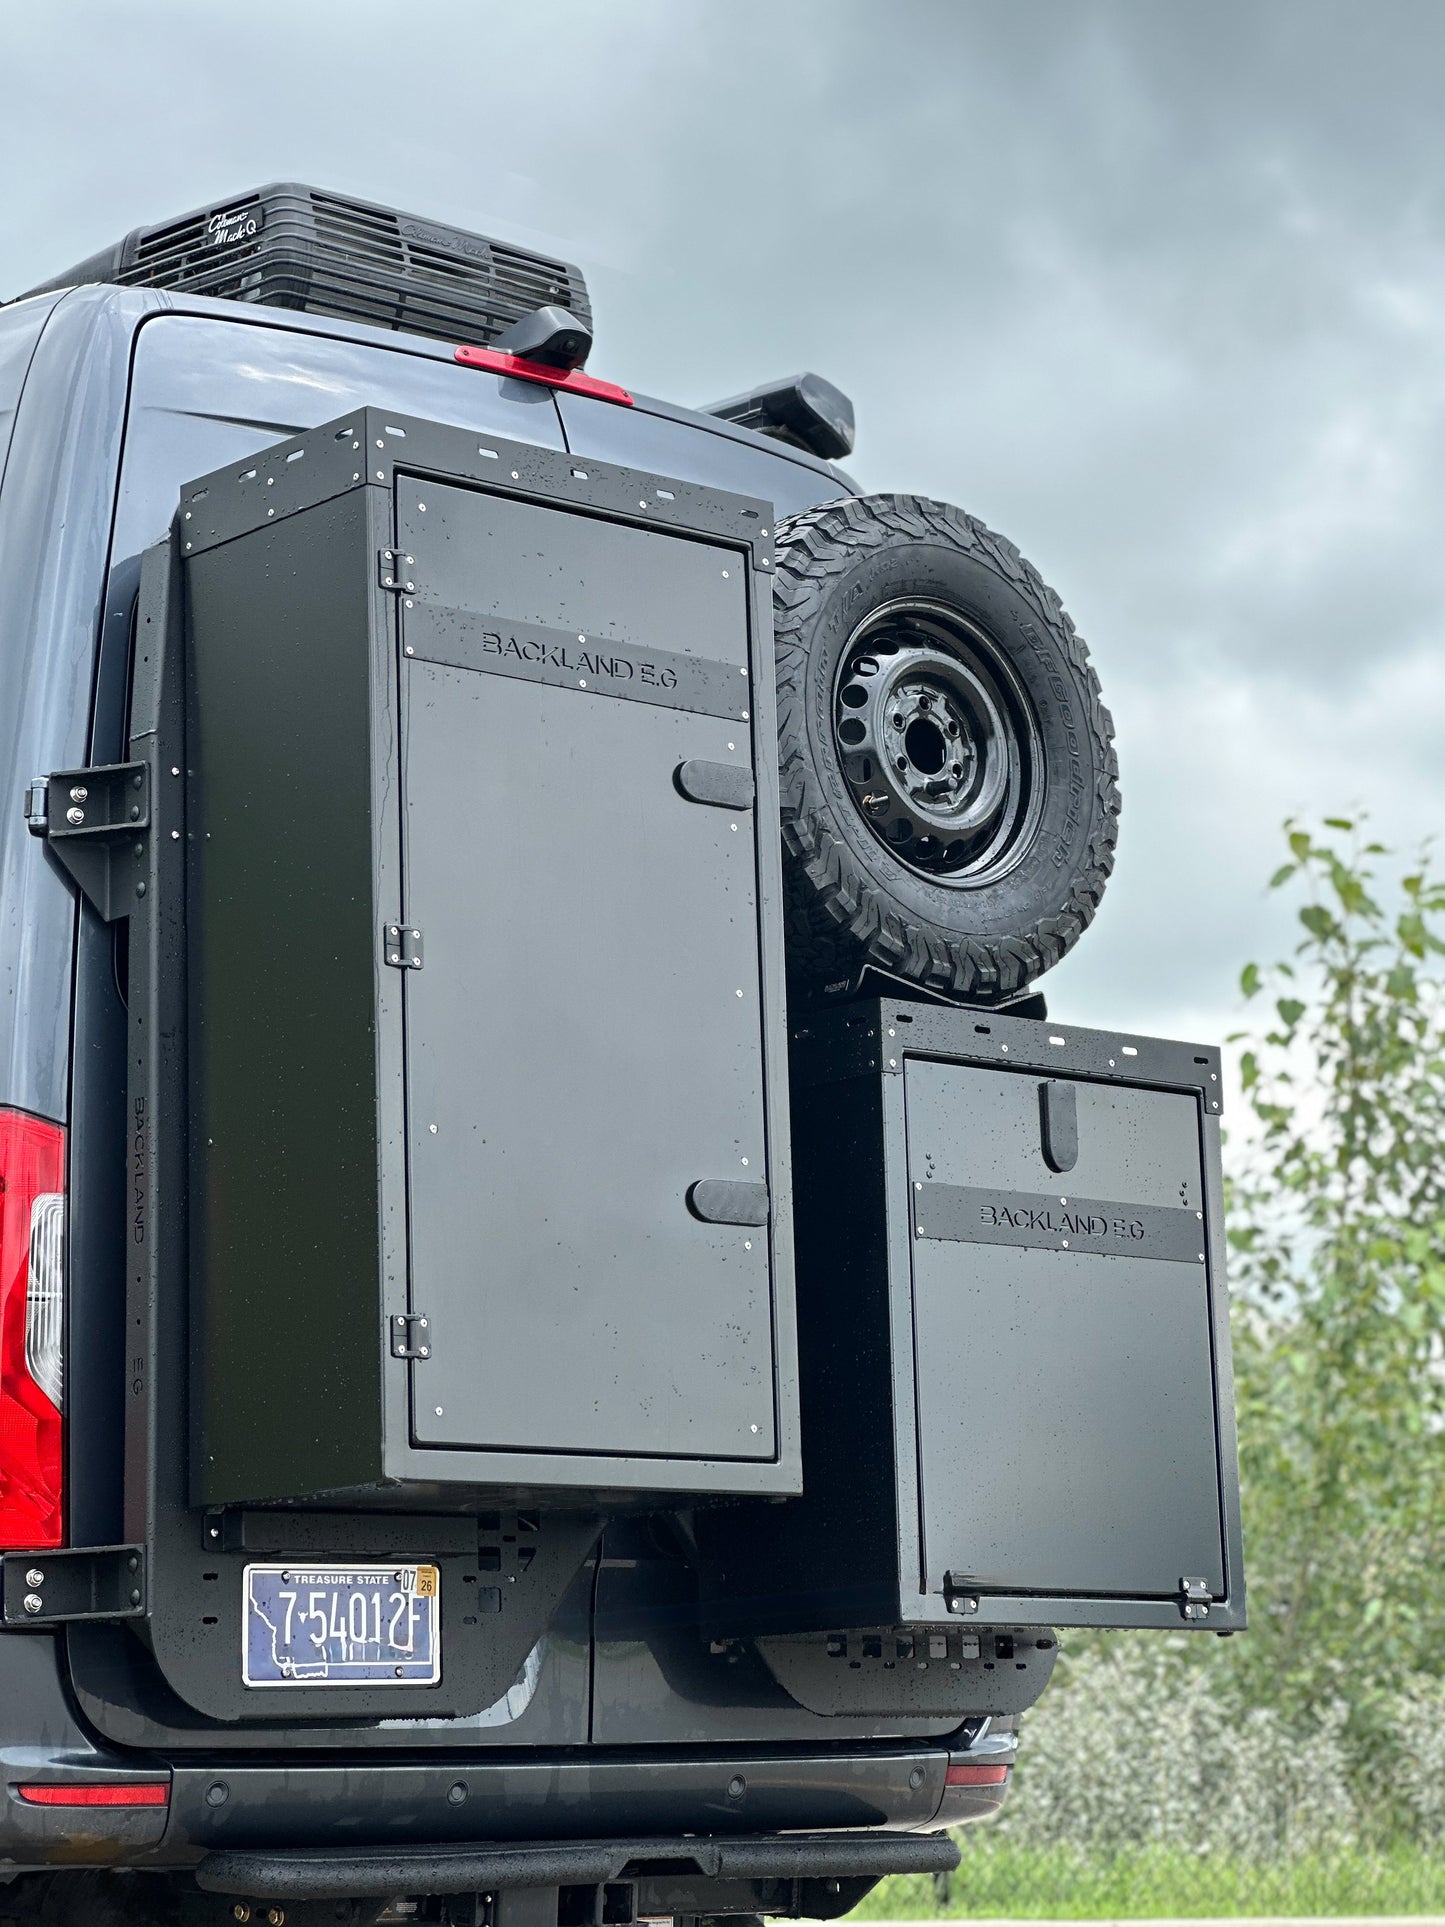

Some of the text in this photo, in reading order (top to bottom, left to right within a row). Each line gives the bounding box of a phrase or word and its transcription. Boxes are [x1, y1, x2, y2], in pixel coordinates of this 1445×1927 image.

[483, 632, 634, 680] BACKLAND
[1018, 621, 1084, 870] BFGoodrich
[132, 1096, 145, 1245] BACKLAND
[980, 1205, 1108, 1237] BACKLAND
[294, 1575, 389, 1585] TREASURE STATE
[402, 1569, 416, 1591] 07
[420, 1580, 432, 1591] 26
